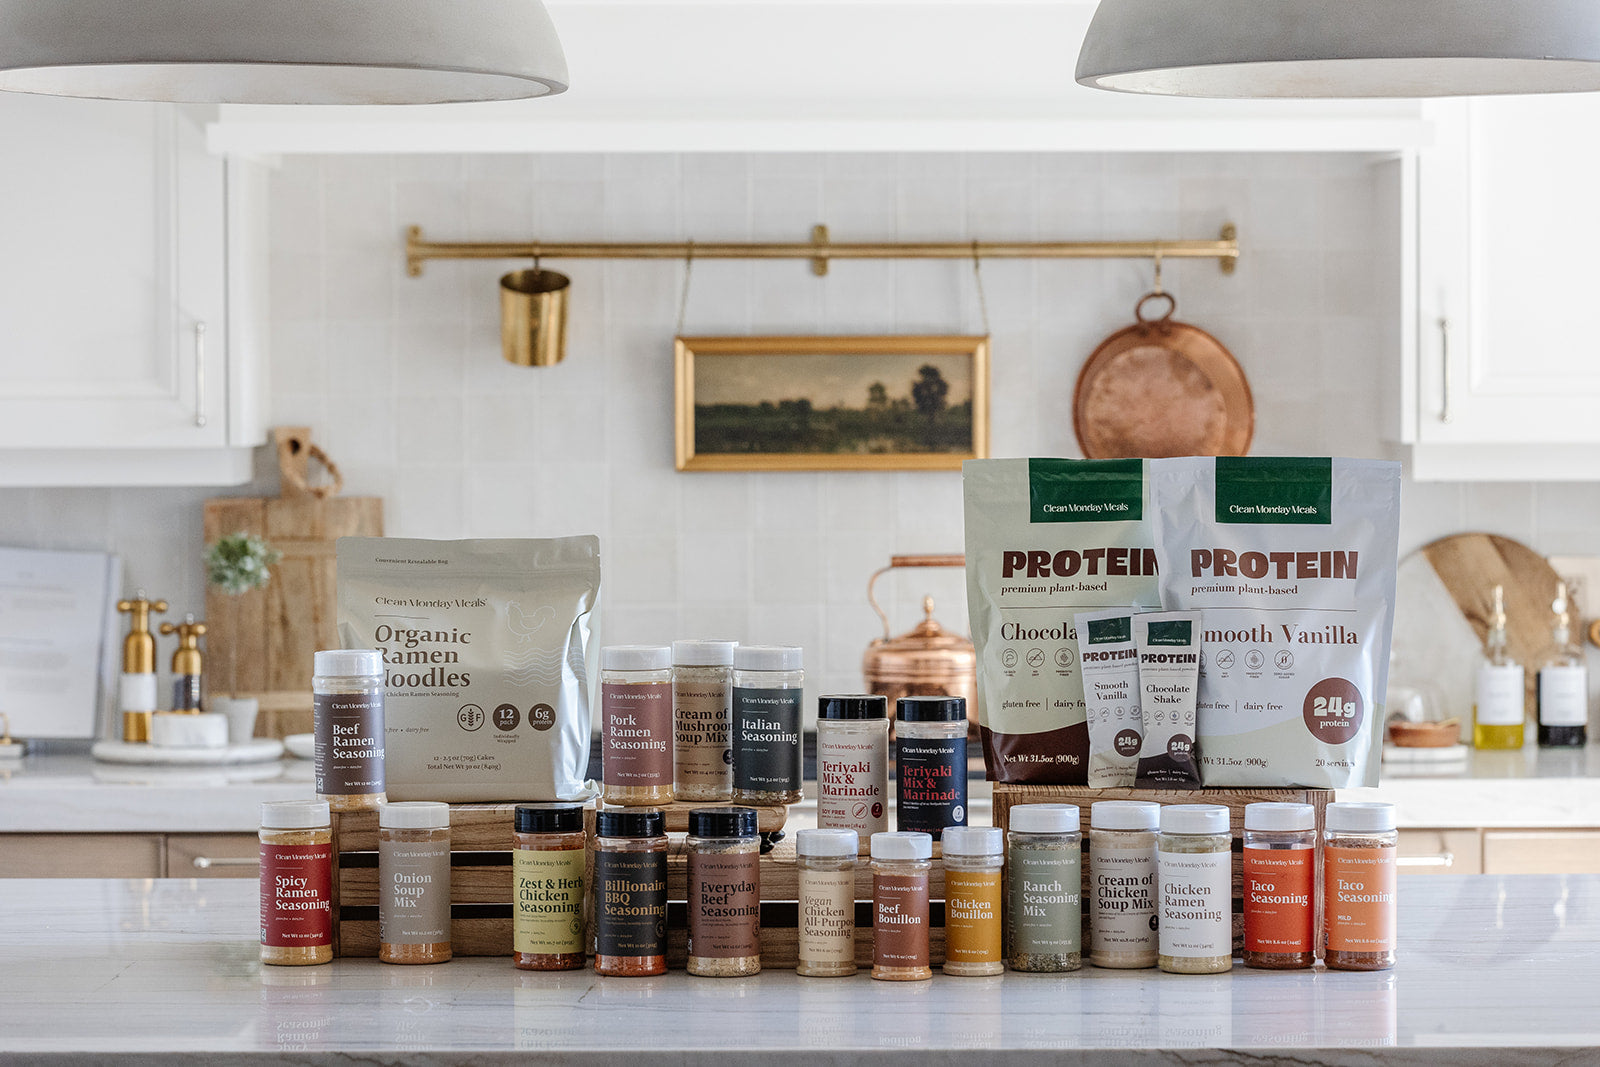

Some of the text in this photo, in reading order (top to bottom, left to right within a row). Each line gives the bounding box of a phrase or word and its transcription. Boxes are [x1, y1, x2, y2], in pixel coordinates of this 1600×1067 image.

[1043, 502, 1128, 514] Clean Monday Meals
[1230, 504, 1317, 516] Clean Monday Meals
[1190, 548, 1358, 580] PROTEIN
[1001, 582, 1108, 596] premium plant-based
[1191, 583, 1298, 596] premium plant-based
[375, 596, 487, 610] Clean Monday Meals
[374, 625, 472, 648] Organic
[1001, 622, 1078, 641] Chocola
[1201, 624, 1358, 644] mooth Vanilla
[1082, 648, 1138, 662] PROTEIN
[1141, 654, 1196, 663] PROTEIN
[1094, 680, 1129, 691] Smooth
[1146, 684, 1190, 693] Chocolate
[430, 692, 460, 700] Seasoning
[1096, 692, 1128, 701] Vanilla
[1153, 696, 1182, 704] Shake
[1002, 700, 1040, 710] gluten free
[1054, 700, 1074, 710] dairy
[1214, 702, 1230, 710] free
[1243, 702, 1283, 712] dairy free
[1313, 696, 1356, 718] 24g
[460, 714, 481, 722] G F
[499, 709, 514, 720] 12
[535, 708, 550, 721] 6g
[610, 714, 636, 726] Pork
[675, 708, 728, 720] Cream of
[333, 724, 360, 735] Beef
[742, 718, 781, 730] Italian
[1320, 719, 1350, 729] protein
[610, 726, 651, 738] Ramen
[675, 732, 728, 744] Soup Mix
[741, 730, 797, 744] Seasoning
[333, 736, 374, 746] Ramen
[610, 738, 666, 752] Seasoning
[1118, 736, 1138, 748] 24g
[1171, 742, 1190, 752] 24g
[333, 747, 385, 760] Seasoning
[1004, 755, 1080, 766] Net Wt 31.5oz (900g)
[1203, 756, 1268, 768] Wt 31.5oz (900g)
[1316, 758, 1325, 766] 20
[822, 761, 870, 775] Teriyaki
[902, 766, 952, 780] Teriyaki
[822, 773, 854, 785] Mix &
[903, 778, 936, 790] Mix &
[822, 785, 880, 796] Marinade
[903, 789, 960, 801] Marinade
[275, 875, 308, 889] Spicy
[394, 873, 432, 884] Onion
[520, 877, 583, 889] Zest & Herb
[1098, 873, 1154, 886] Cream of
[1337, 878, 1364, 891] Taco
[394, 884, 424, 898] Soup
[701, 881, 756, 896] Everyday
[1023, 880, 1062, 892] Ranch
[1164, 884, 1211, 895] Chicken
[1250, 880, 1275, 892] Taco
[276, 888, 318, 898] Ramen
[520, 890, 569, 901] Chicken
[701, 893, 729, 904] Beef
[1098, 886, 1148, 899] Chicken
[1337, 892, 1394, 905] Seasoning
[394, 897, 417, 908] Mix
[604, 892, 630, 906] BBQ
[805, 896, 832, 908] Vegan
[950, 899, 991, 910] Chicken
[1022, 893, 1079, 905] Seasoning
[1098, 898, 1154, 912] Soup Mix
[1164, 896, 1205, 907] Ramen
[1250, 892, 1308, 906] Seasoning
[276, 900, 330, 912] Seasoning
[520, 902, 580, 914] Seasoning
[604, 904, 665, 918] Seasoning
[701, 904, 760, 918] Seasoning
[804, 906, 845, 917] Chicken
[878, 904, 901, 914] Beef
[1022, 906, 1046, 917] Mix
[878, 914, 922, 924] Bouillon
[951, 910, 993, 920] Bouillon
[1164, 908, 1222, 922] Seasoning
[804, 928, 851, 939] Seasoning
